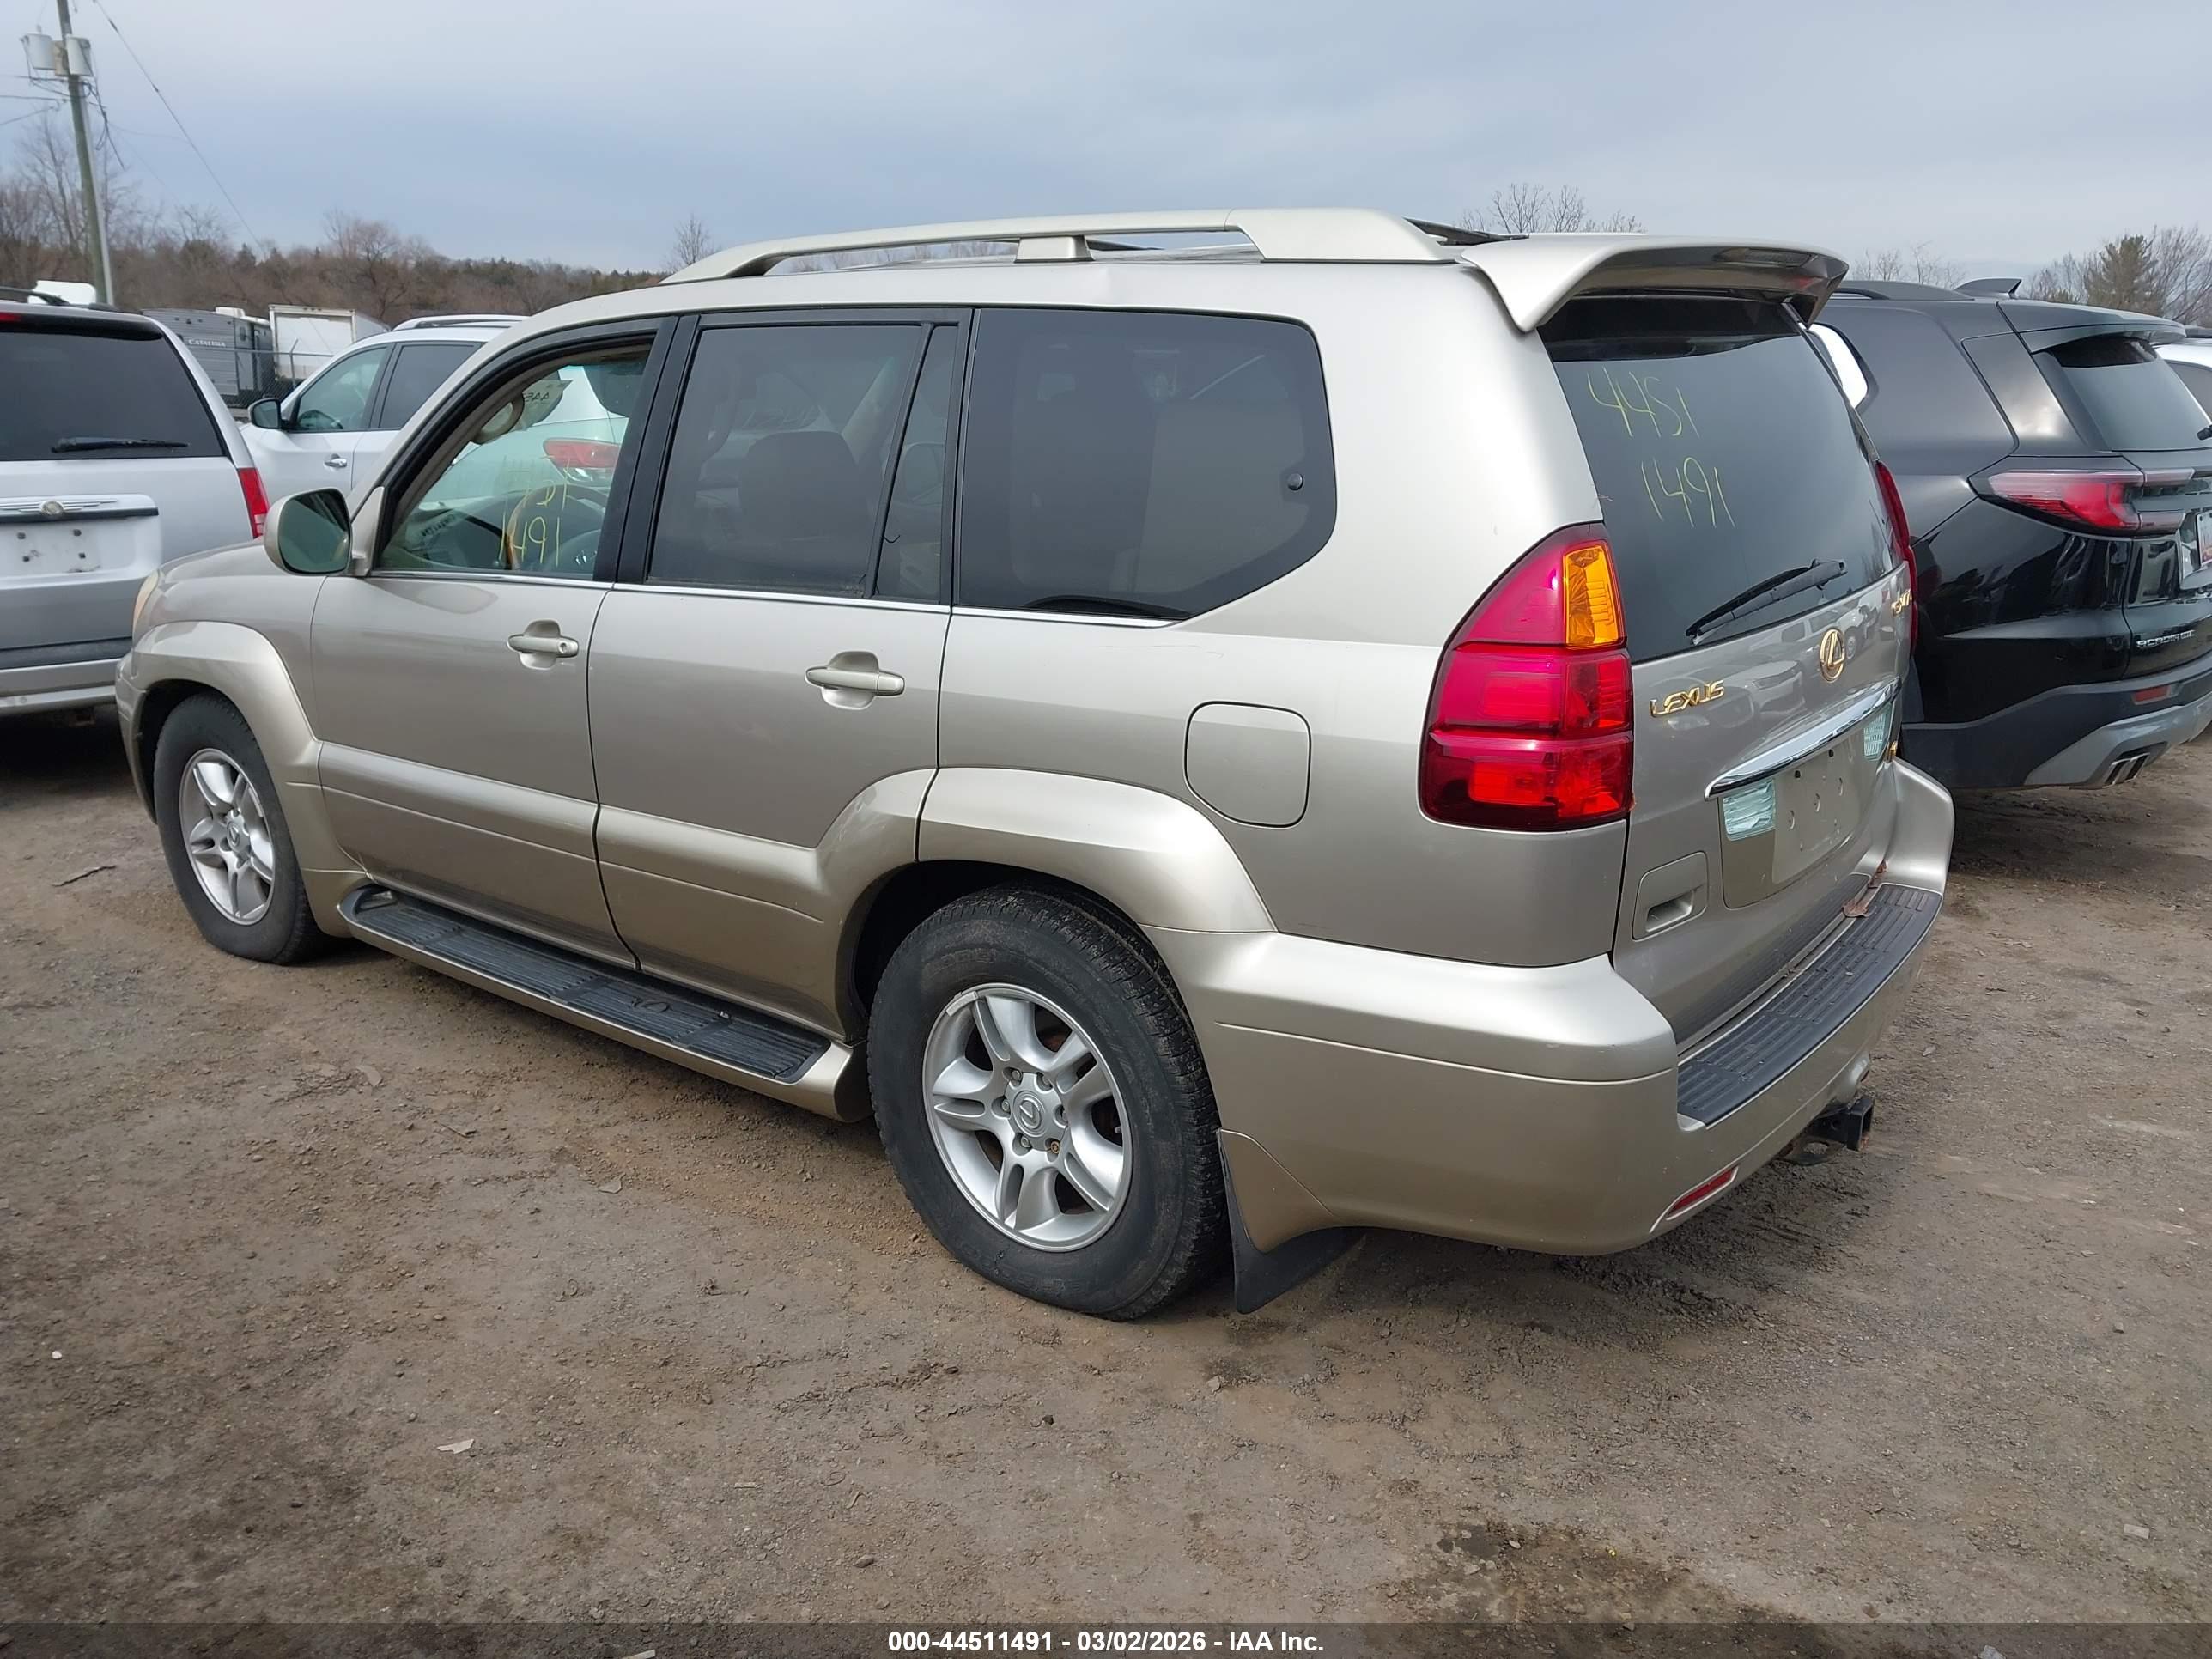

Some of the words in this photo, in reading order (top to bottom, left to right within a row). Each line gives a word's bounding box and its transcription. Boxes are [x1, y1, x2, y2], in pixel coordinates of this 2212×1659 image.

[1587, 365, 1700, 438] 4451
[1640, 457, 1736, 529] 1491
[1650, 679, 1725, 718] LEXUS
